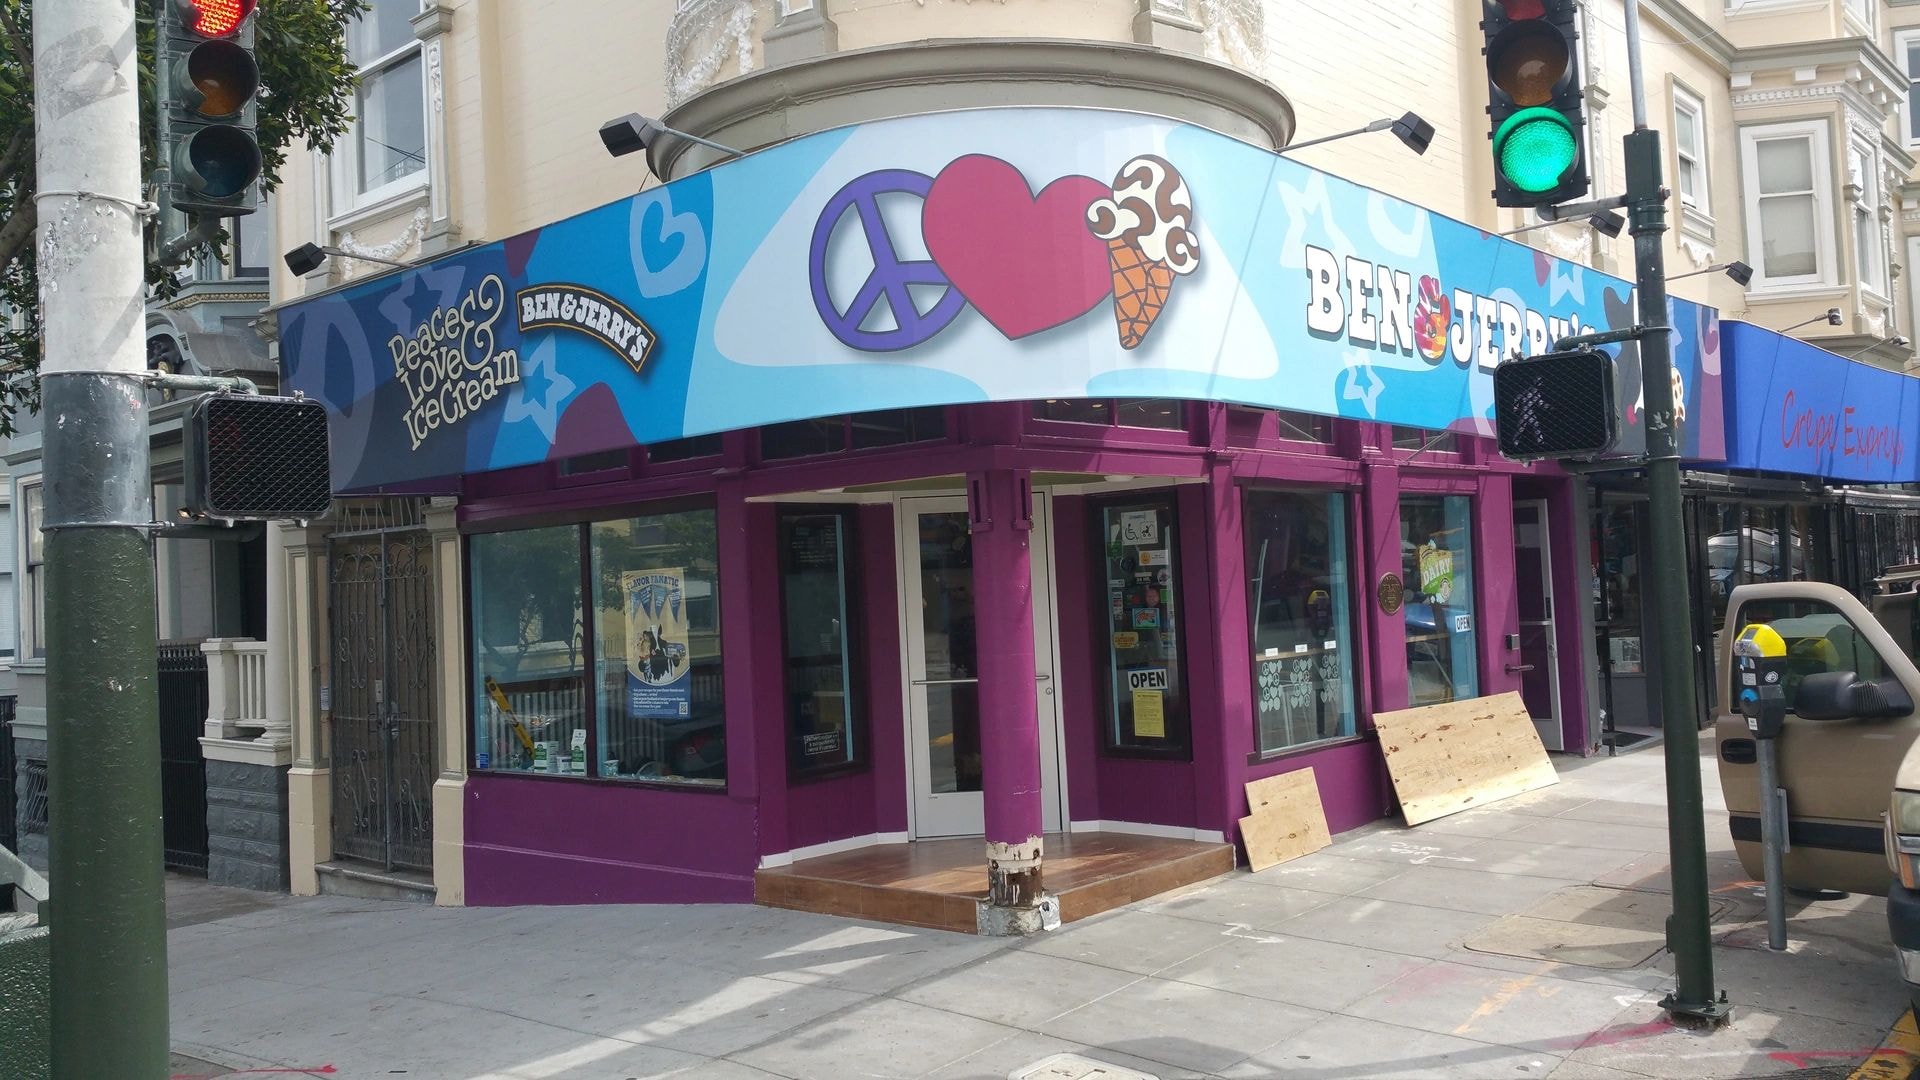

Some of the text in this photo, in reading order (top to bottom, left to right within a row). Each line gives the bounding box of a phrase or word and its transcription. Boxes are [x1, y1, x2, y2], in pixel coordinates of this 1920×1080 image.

[387, 274, 505, 378] Peace &
[400, 346, 463, 411] Love
[1781, 389, 1839, 465] Crepe
[1423, 558, 1450, 585] DAIRY
[1457, 616, 1471, 630] OPEN
[1131, 671, 1165, 688] OPEN
